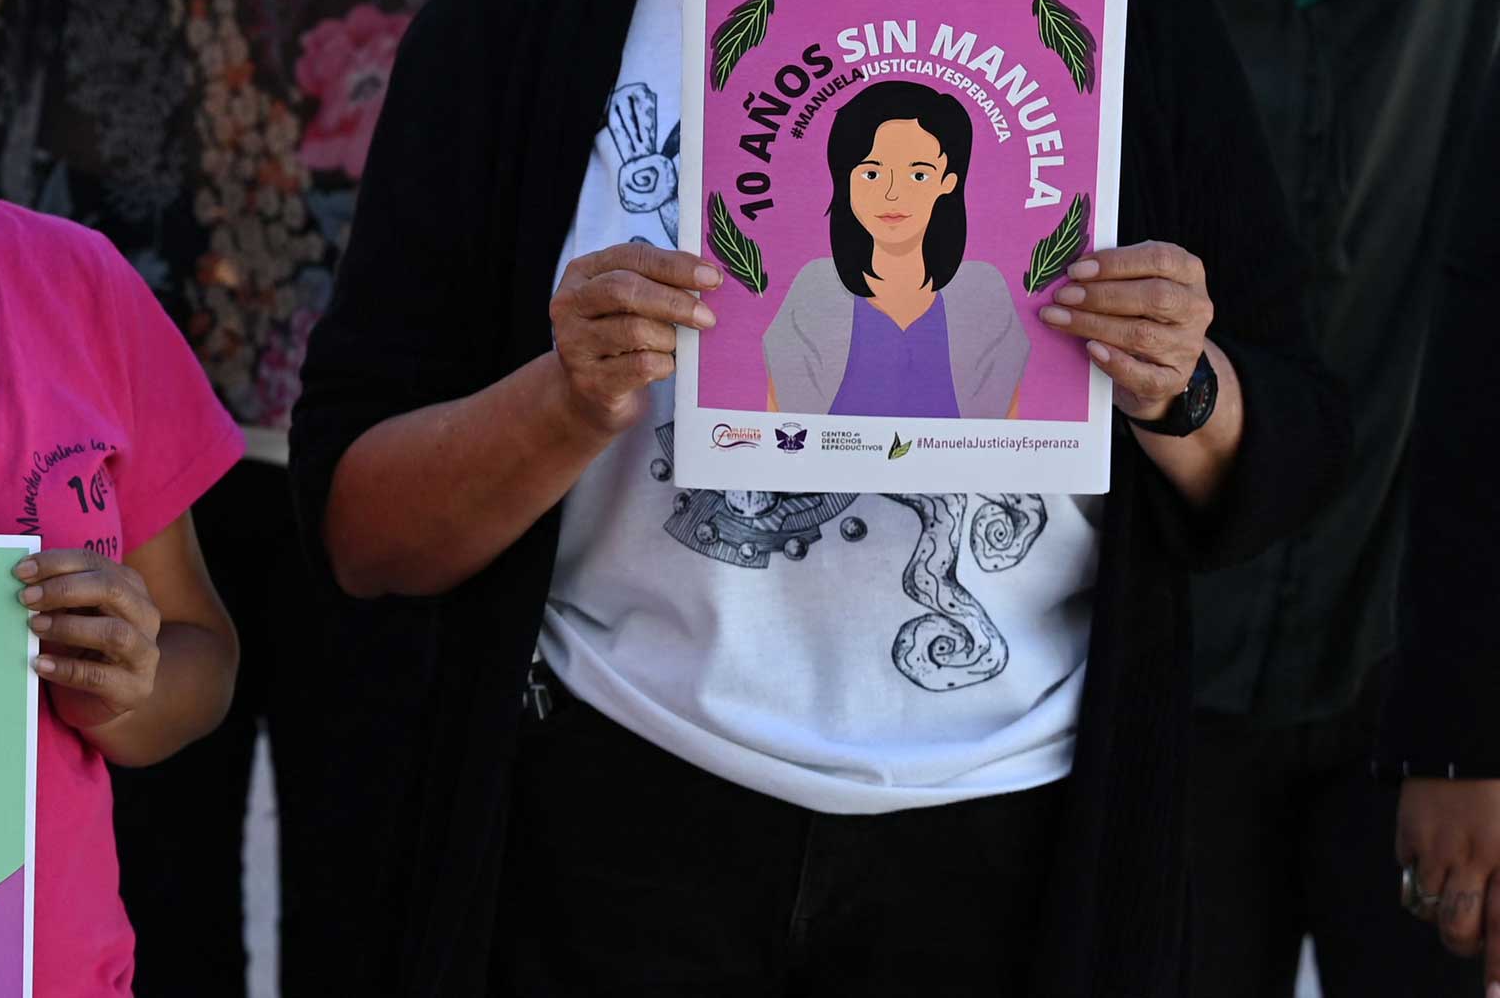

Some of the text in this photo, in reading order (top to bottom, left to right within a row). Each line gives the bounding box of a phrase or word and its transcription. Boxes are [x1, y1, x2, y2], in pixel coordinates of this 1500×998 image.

[736, 19, 1065, 222] 10 AÑOS SIN MANUELA
[821, 437, 862, 445] DERECHOS
[916, 436, 1080, 452] #ManuelaJusticiayEsperanza
